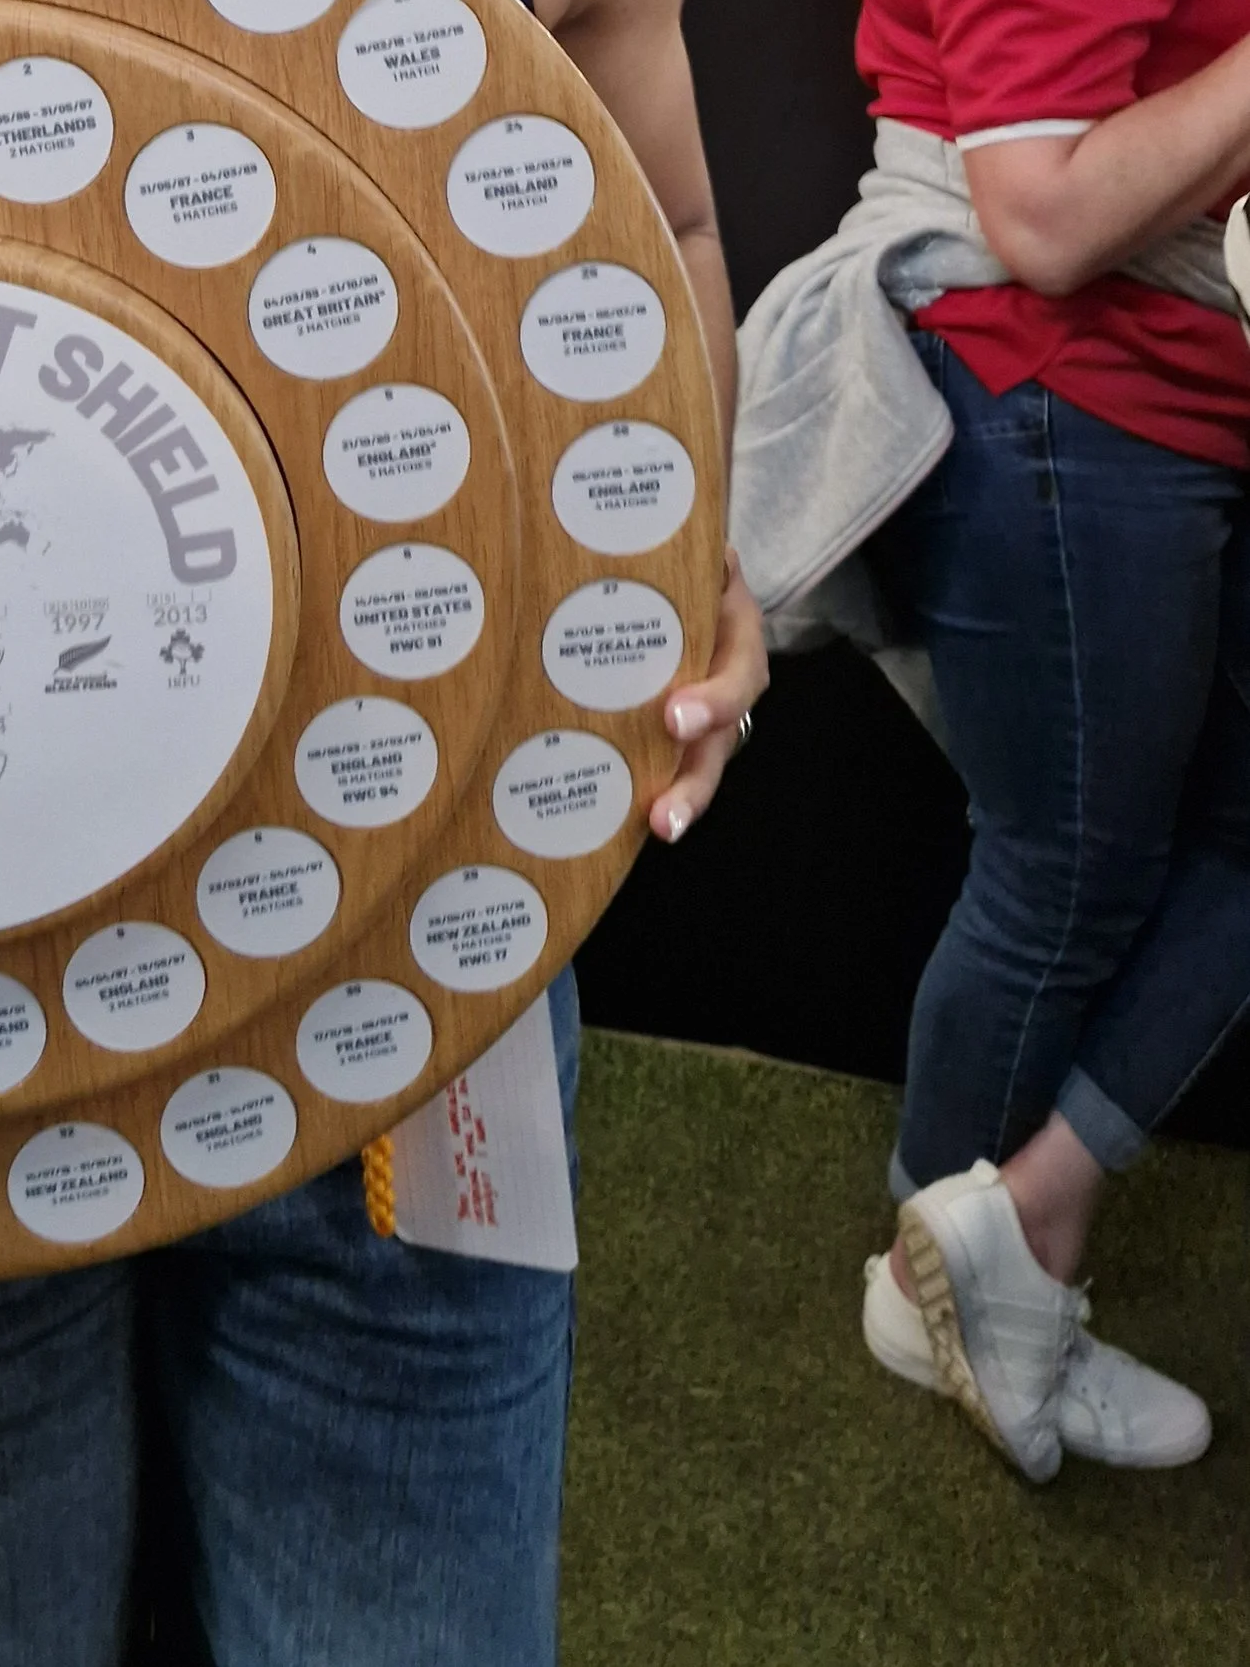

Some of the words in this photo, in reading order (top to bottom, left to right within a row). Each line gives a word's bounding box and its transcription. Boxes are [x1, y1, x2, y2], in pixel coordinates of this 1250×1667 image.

[384, 47, 440, 70] WALES
[23, 63, 32, 76] 2
[400, 65, 440, 81] MATCH
[18, 138, 74, 156] MATCHES
[170, 184, 234, 209] FRANCE
[484, 177, 558, 200] ENGLAND
[183, 202, 238, 222] MATCHES
[508, 195, 548, 209] MATCH
[262, 304, 313, 329] GREAT
[306, 314, 360, 334] MATCHES
[562, 324, 624, 343] FRANCE
[38, 335, 237, 584] SHIELD
[378, 460, 432, 477] MATCHES
[588, 480, 660, 499] ENGLAND
[52, 613, 104, 634] 1997
[154, 605, 208, 627] 2013
[354, 608, 410, 626] UNITED
[412, 600, 472, 618] STATES
[392, 619, 446, 634] MATCHES
[390, 638, 425, 654] RWC
[559, 644, 593, 658] NEW
[596, 634, 667, 655] ZEALAND
[355, 699, 364, 712] 7
[331, 754, 402, 775] ENGLAND
[343, 786, 376, 804] RWC
[528, 784, 598, 808] ENGLAND
[239, 882, 298, 905] FRANCE
[426, 930, 459, 945] NEW
[462, 914, 531, 939] ZEALAND
[459, 952, 492, 968] RWC
[495, 949, 507, 962] 17
[99, 973, 169, 1002] ENGLAND
[336, 1031, 392, 1054] FRANCE
[196, 1114, 262, 1143] ENGLAND
[25, 1183, 57, 1198] NEW
[60, 1169, 128, 1191] ZEALAND
